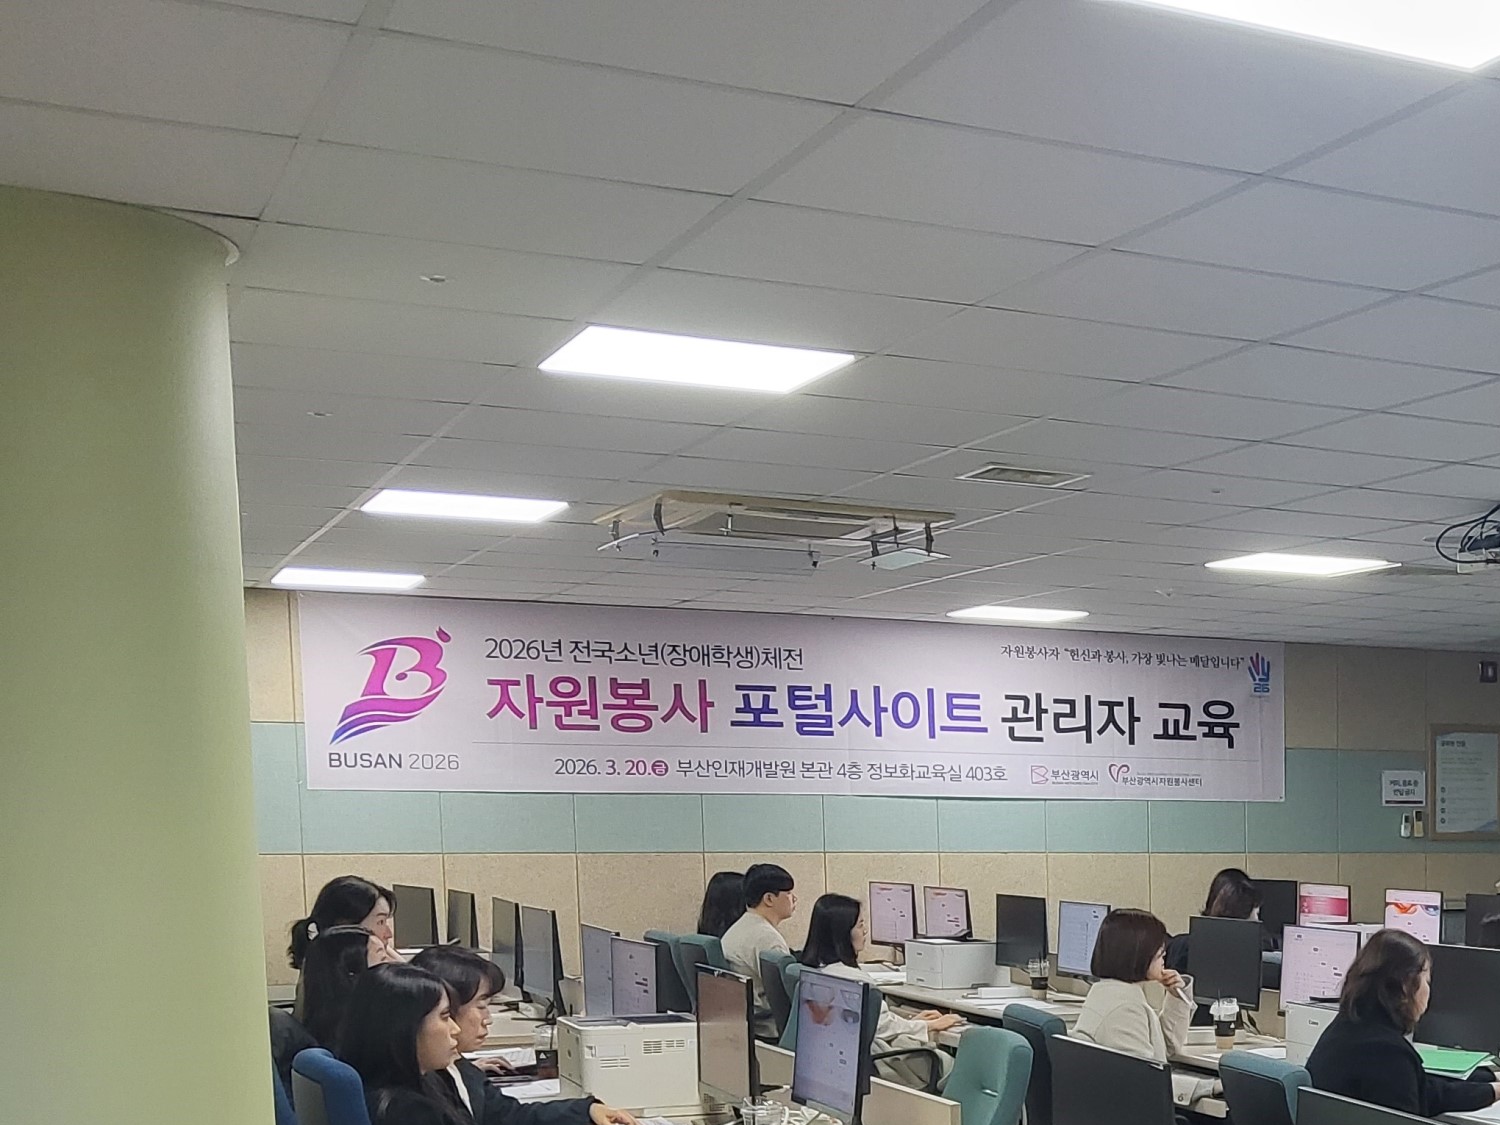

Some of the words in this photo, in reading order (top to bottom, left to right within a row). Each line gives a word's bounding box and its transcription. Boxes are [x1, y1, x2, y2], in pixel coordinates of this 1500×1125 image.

[484, 638, 564, 661] 2026년
[569, 640, 804, 671] 전국소년(장애학생)체전
[1000, 644, 1061, 661] 자원봉사자
[1132, 651, 1153, 667] 가장
[1156, 652, 1188, 668] 빛나는
[486, 673, 715, 734] 자원봉사
[729, 683, 989, 741] 포털사이트
[1000, 692, 1141, 746] 관리자
[1152, 700, 1241, 749] 교육
[328, 752, 403, 770] BUSAN
[408, 753, 460, 771] 2026
[554, 758, 601, 776] 2026.
[605, 759, 621, 776] 3.
[675, 759, 797, 780] 부산인재개발원
[799, 761, 834, 780] 본관
[836, 762, 864, 781] 4층
[867, 761, 963, 784] 정보화교육실
[965, 765, 1008, 783] 403호
[1050, 769, 1099, 781] 부산광역시
